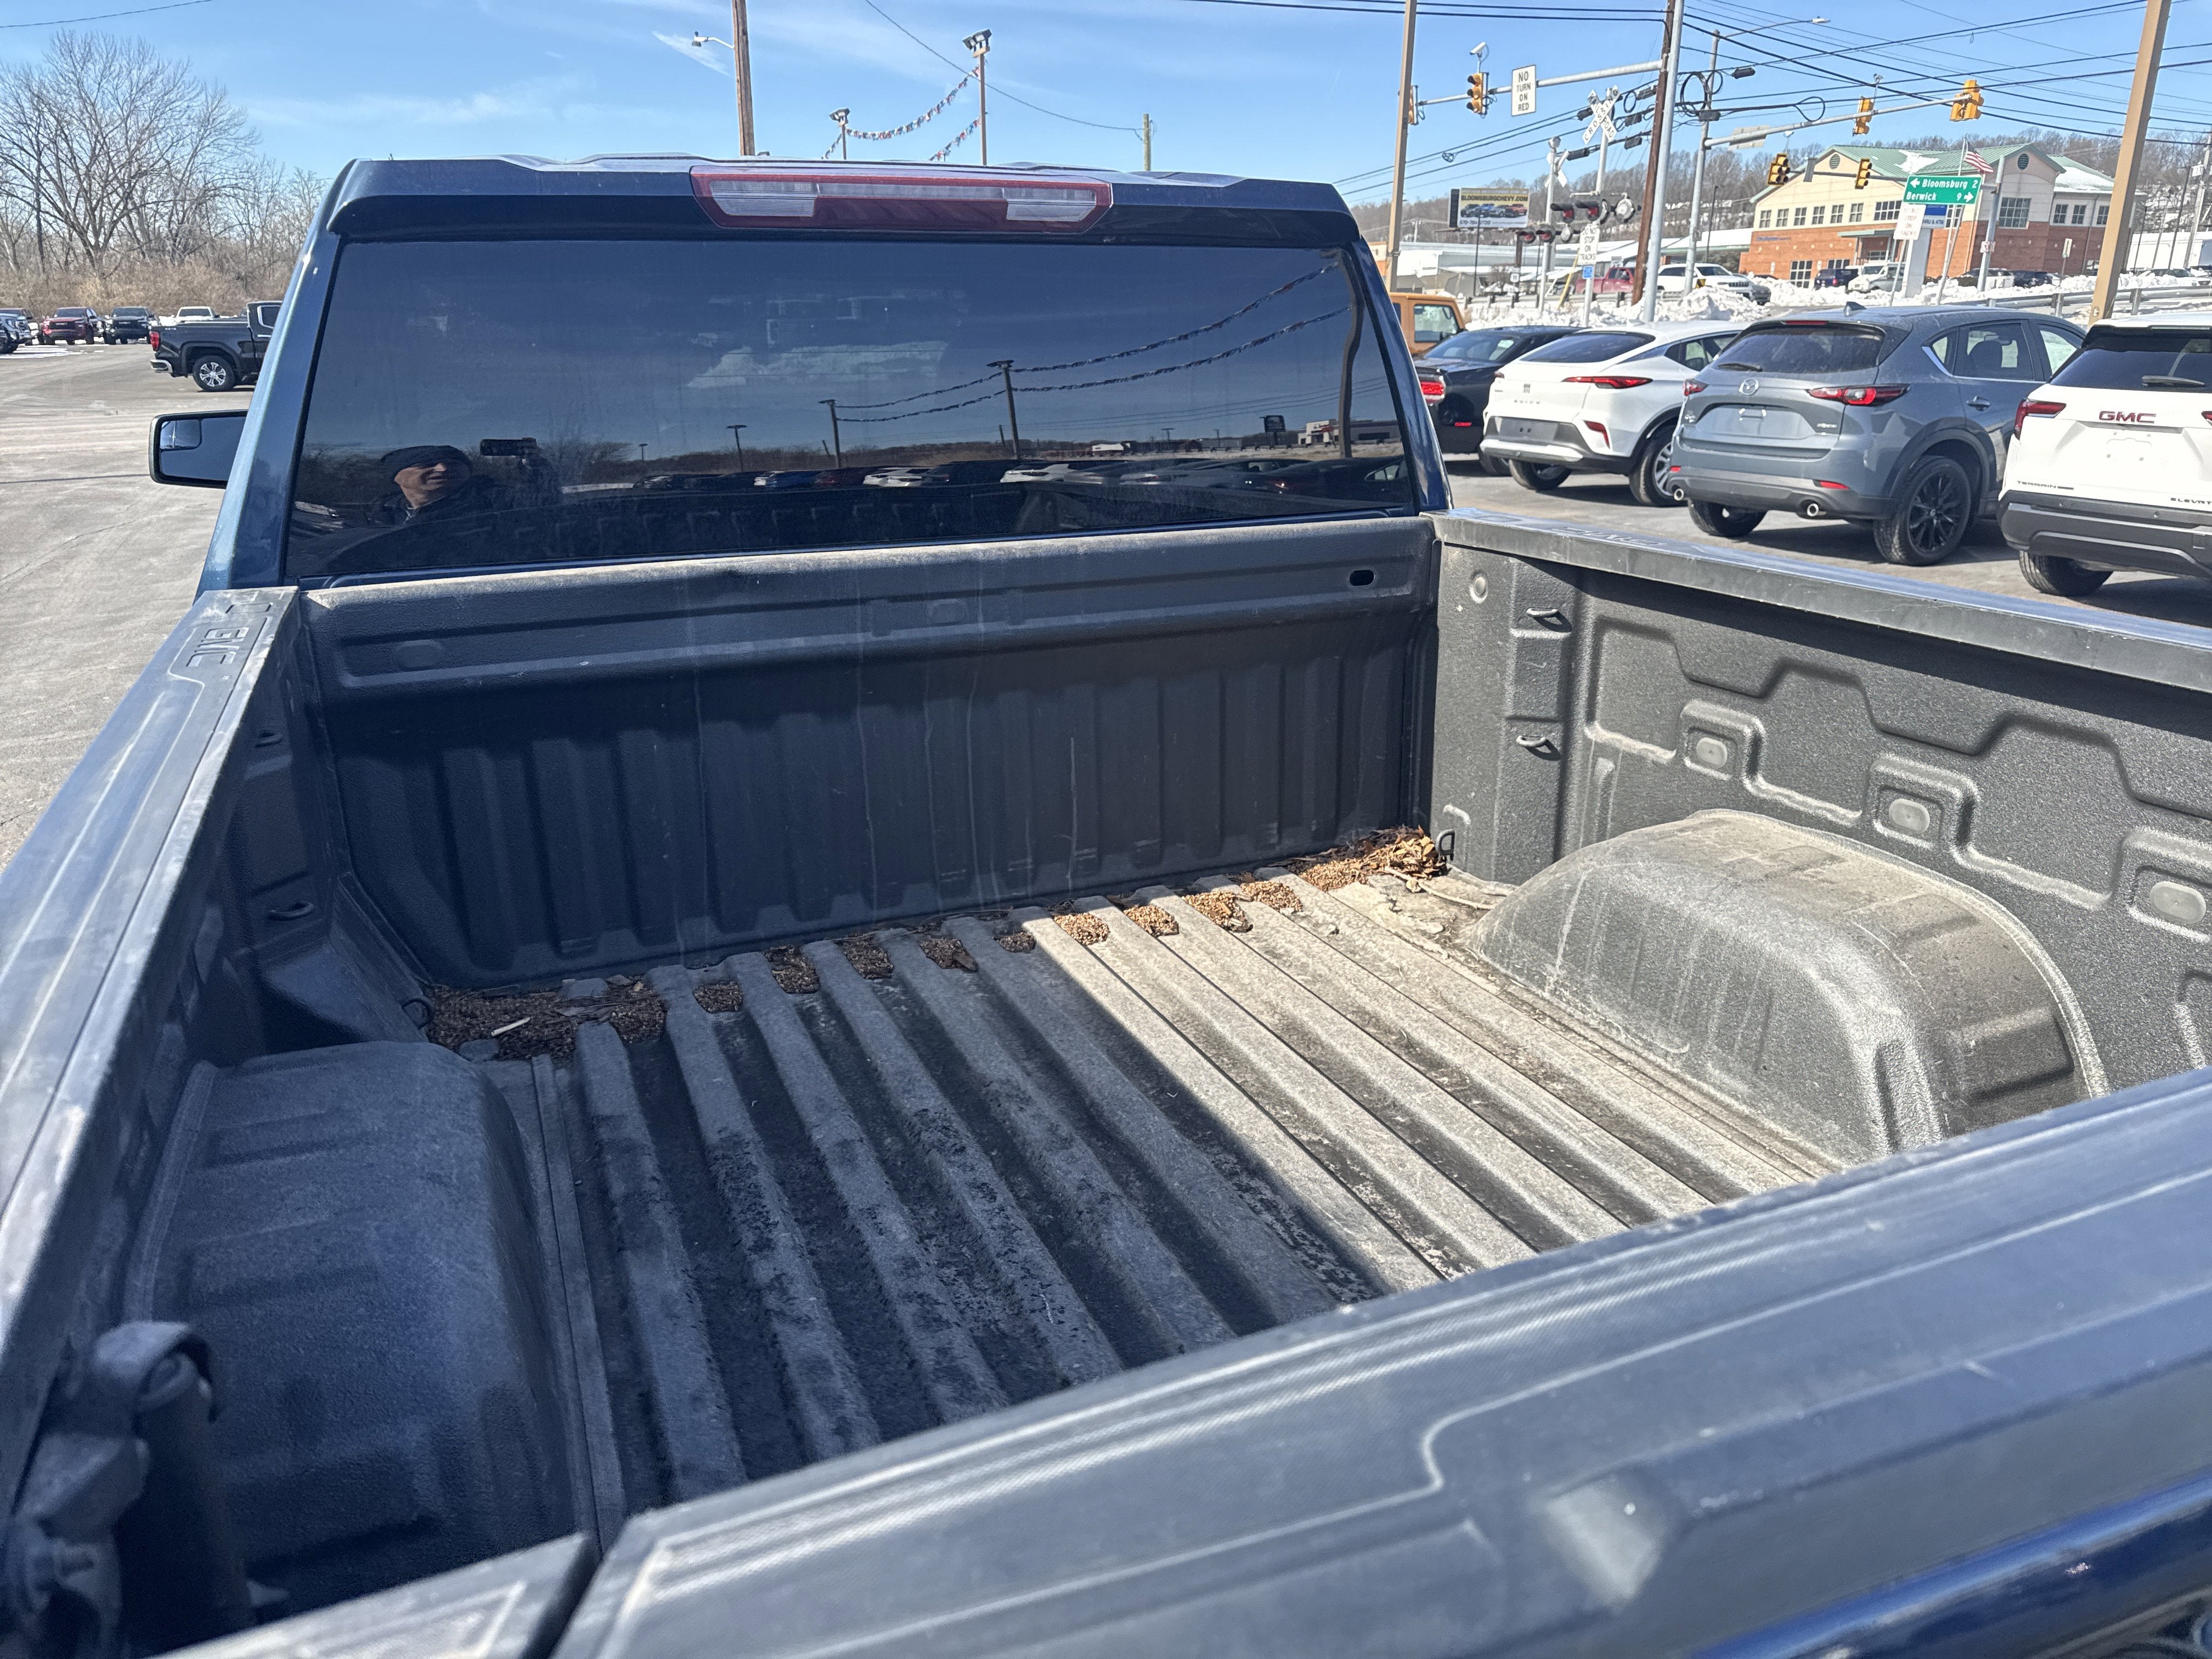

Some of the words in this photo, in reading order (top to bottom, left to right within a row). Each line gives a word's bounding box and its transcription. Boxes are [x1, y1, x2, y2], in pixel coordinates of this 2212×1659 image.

[1519, 71, 1529, 82] NO
[1516, 82, 1531, 92] TURN
[1519, 93, 1528, 101] ON
[1518, 103, 1530, 111] RED
[1584, 89, 1618, 140] CROSSING
[1588, 93, 1615, 138] RAILROAD
[1922, 179, 1968, 190] Bloomsburg
[1972, 179, 1978, 189] 2
[1906, 191, 1937, 201] Berwick
[1956, 192, 1962, 201] 9
[2098, 410, 2157, 424] GMC
[2017, 480, 2057, 489] TERRAIN
[186, 627, 250, 668] GMC
